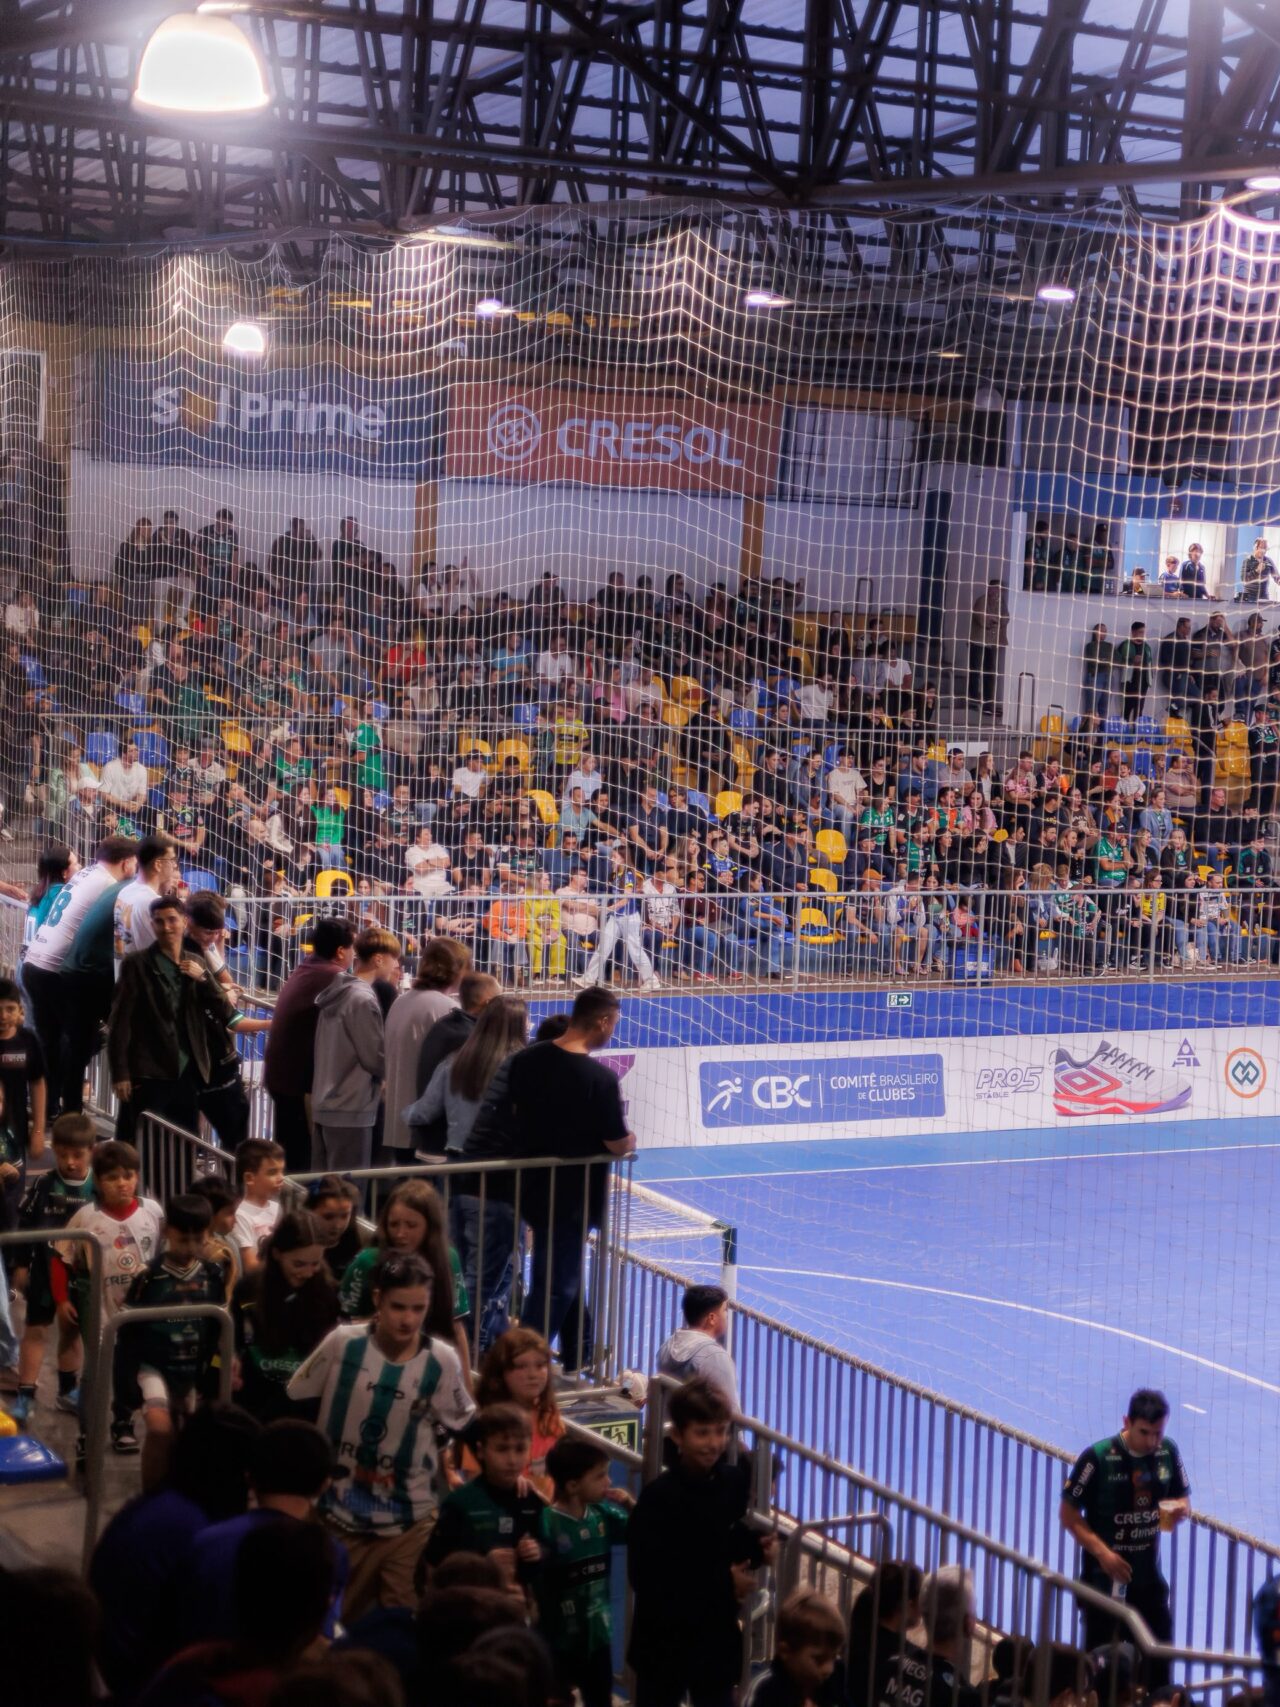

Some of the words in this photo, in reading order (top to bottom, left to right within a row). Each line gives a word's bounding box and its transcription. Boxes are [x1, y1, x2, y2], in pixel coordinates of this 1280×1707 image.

[240, 390, 387, 439] Prime
[557, 418, 743, 466] CRESOL
[752, 1075, 812, 1110] CBC
[830, 1072, 878, 1090] COMITÊ
[880, 1072, 939, 1087] BRASILEIRO
[868, 1087, 916, 1102] CLUBES
